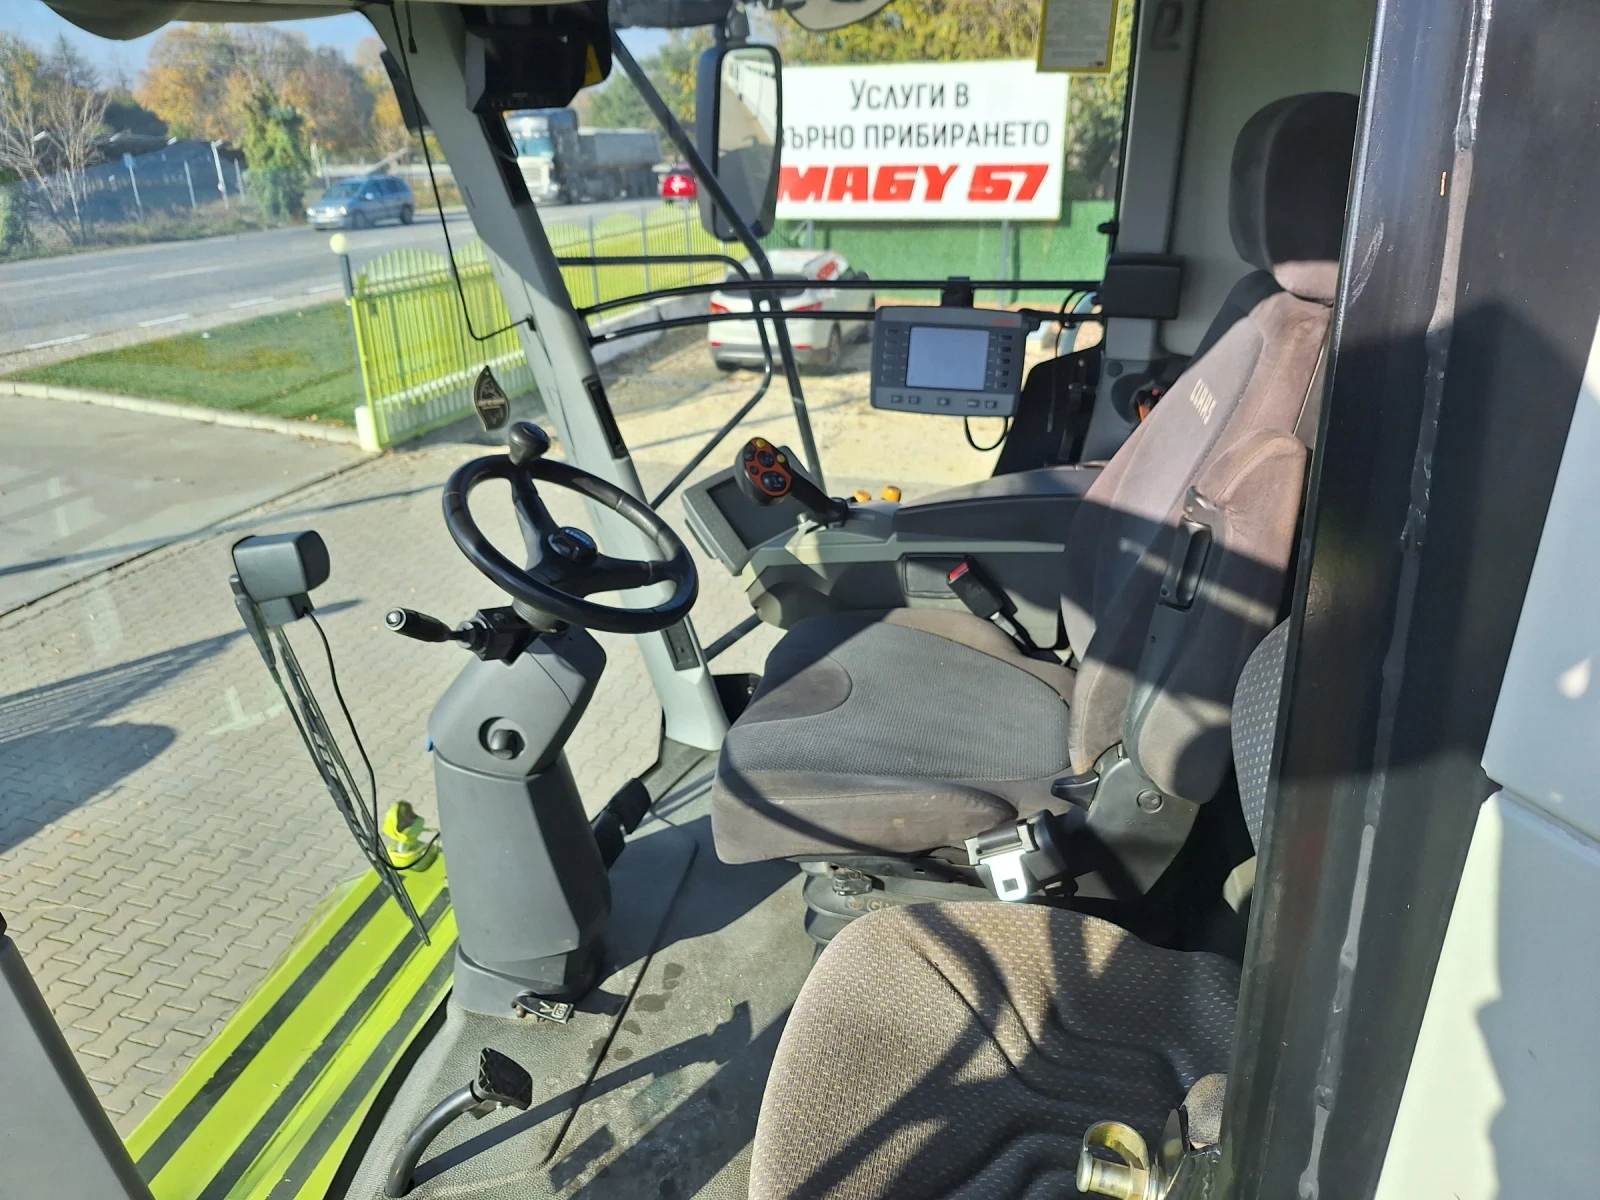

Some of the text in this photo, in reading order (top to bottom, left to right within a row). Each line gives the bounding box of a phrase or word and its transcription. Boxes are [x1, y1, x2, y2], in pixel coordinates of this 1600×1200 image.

[955, 83, 969, 108] В
[864, 121, 1049, 149] ПРИБИРАНЕТО
[967, 164, 1049, 202] 57
